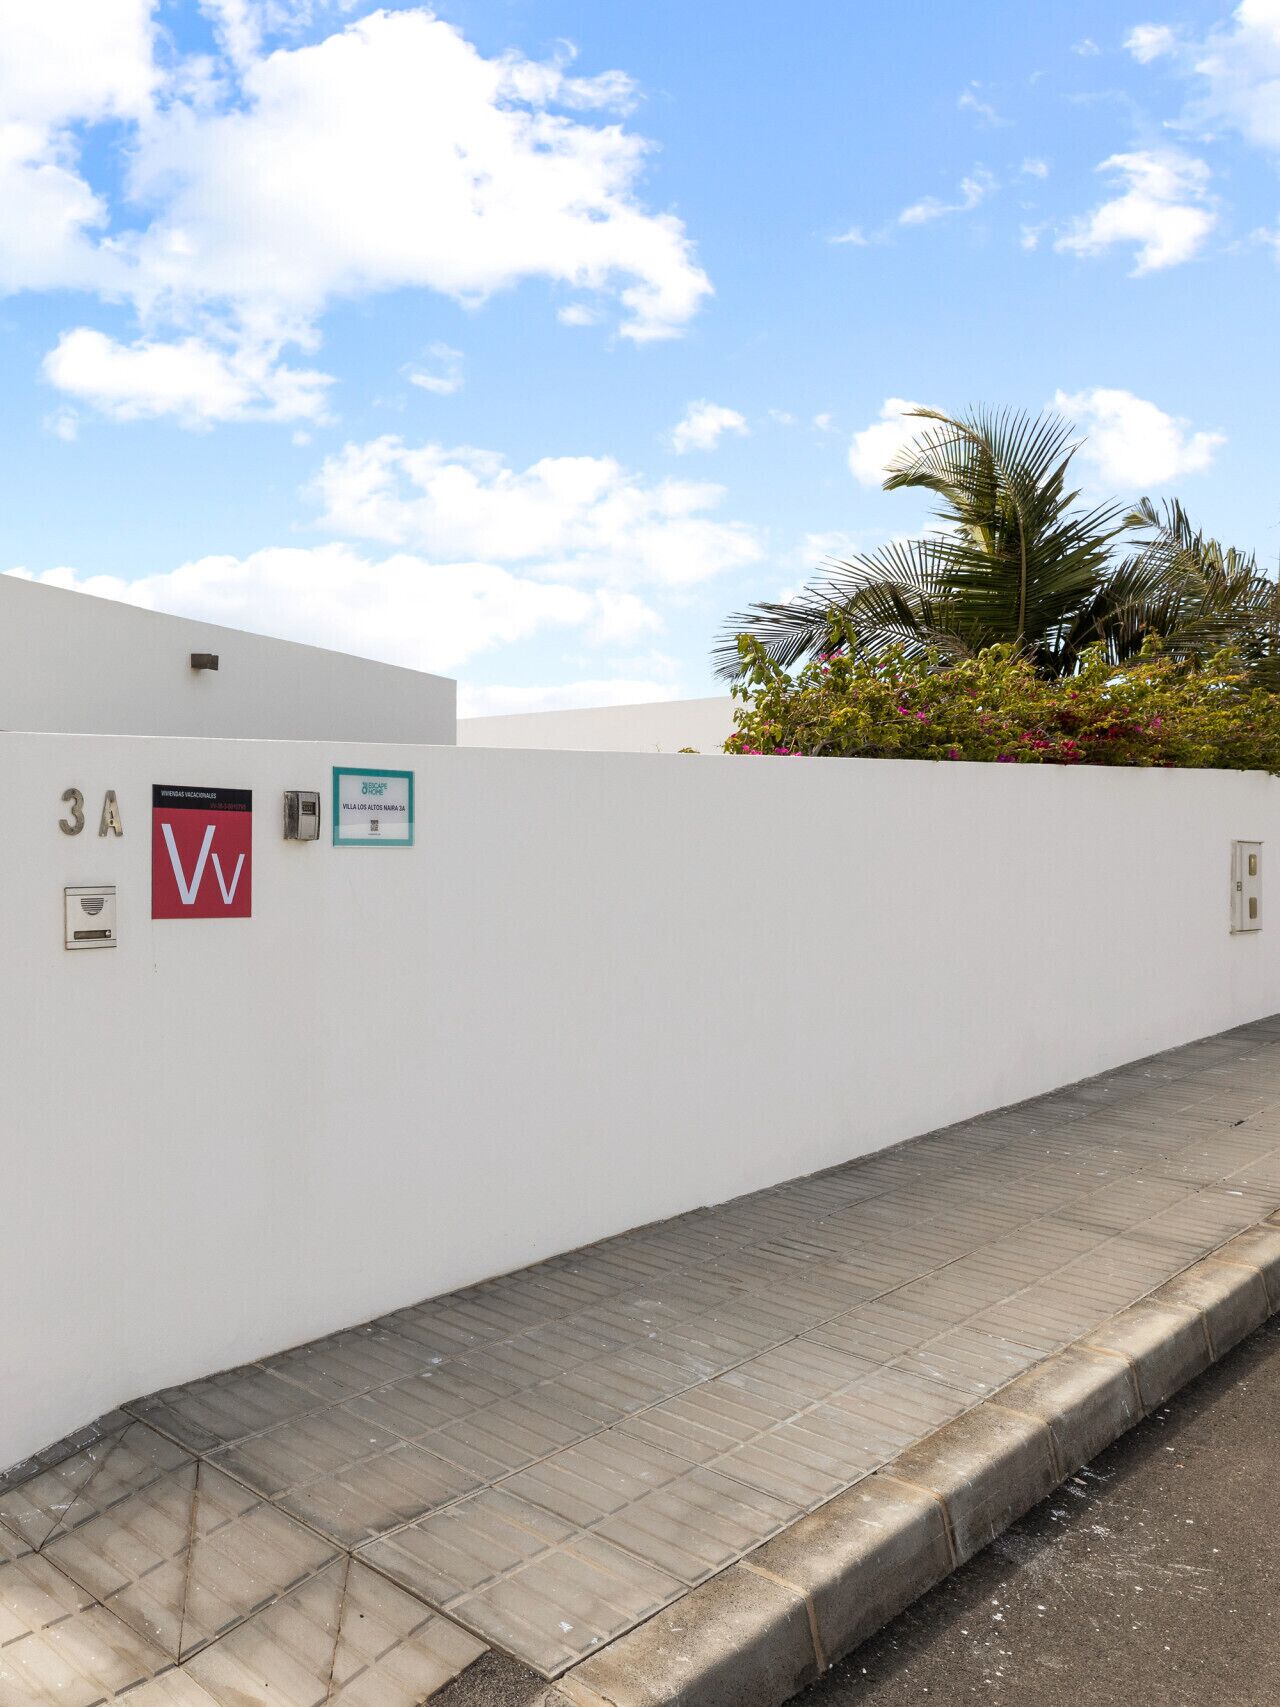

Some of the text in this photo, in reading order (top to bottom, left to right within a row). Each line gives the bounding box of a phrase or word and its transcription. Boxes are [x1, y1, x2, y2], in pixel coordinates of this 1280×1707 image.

[369, 782, 388, 790] ESCAPE
[185, 791, 217, 799] VACACIONALES
[369, 788, 384, 796] HOME
